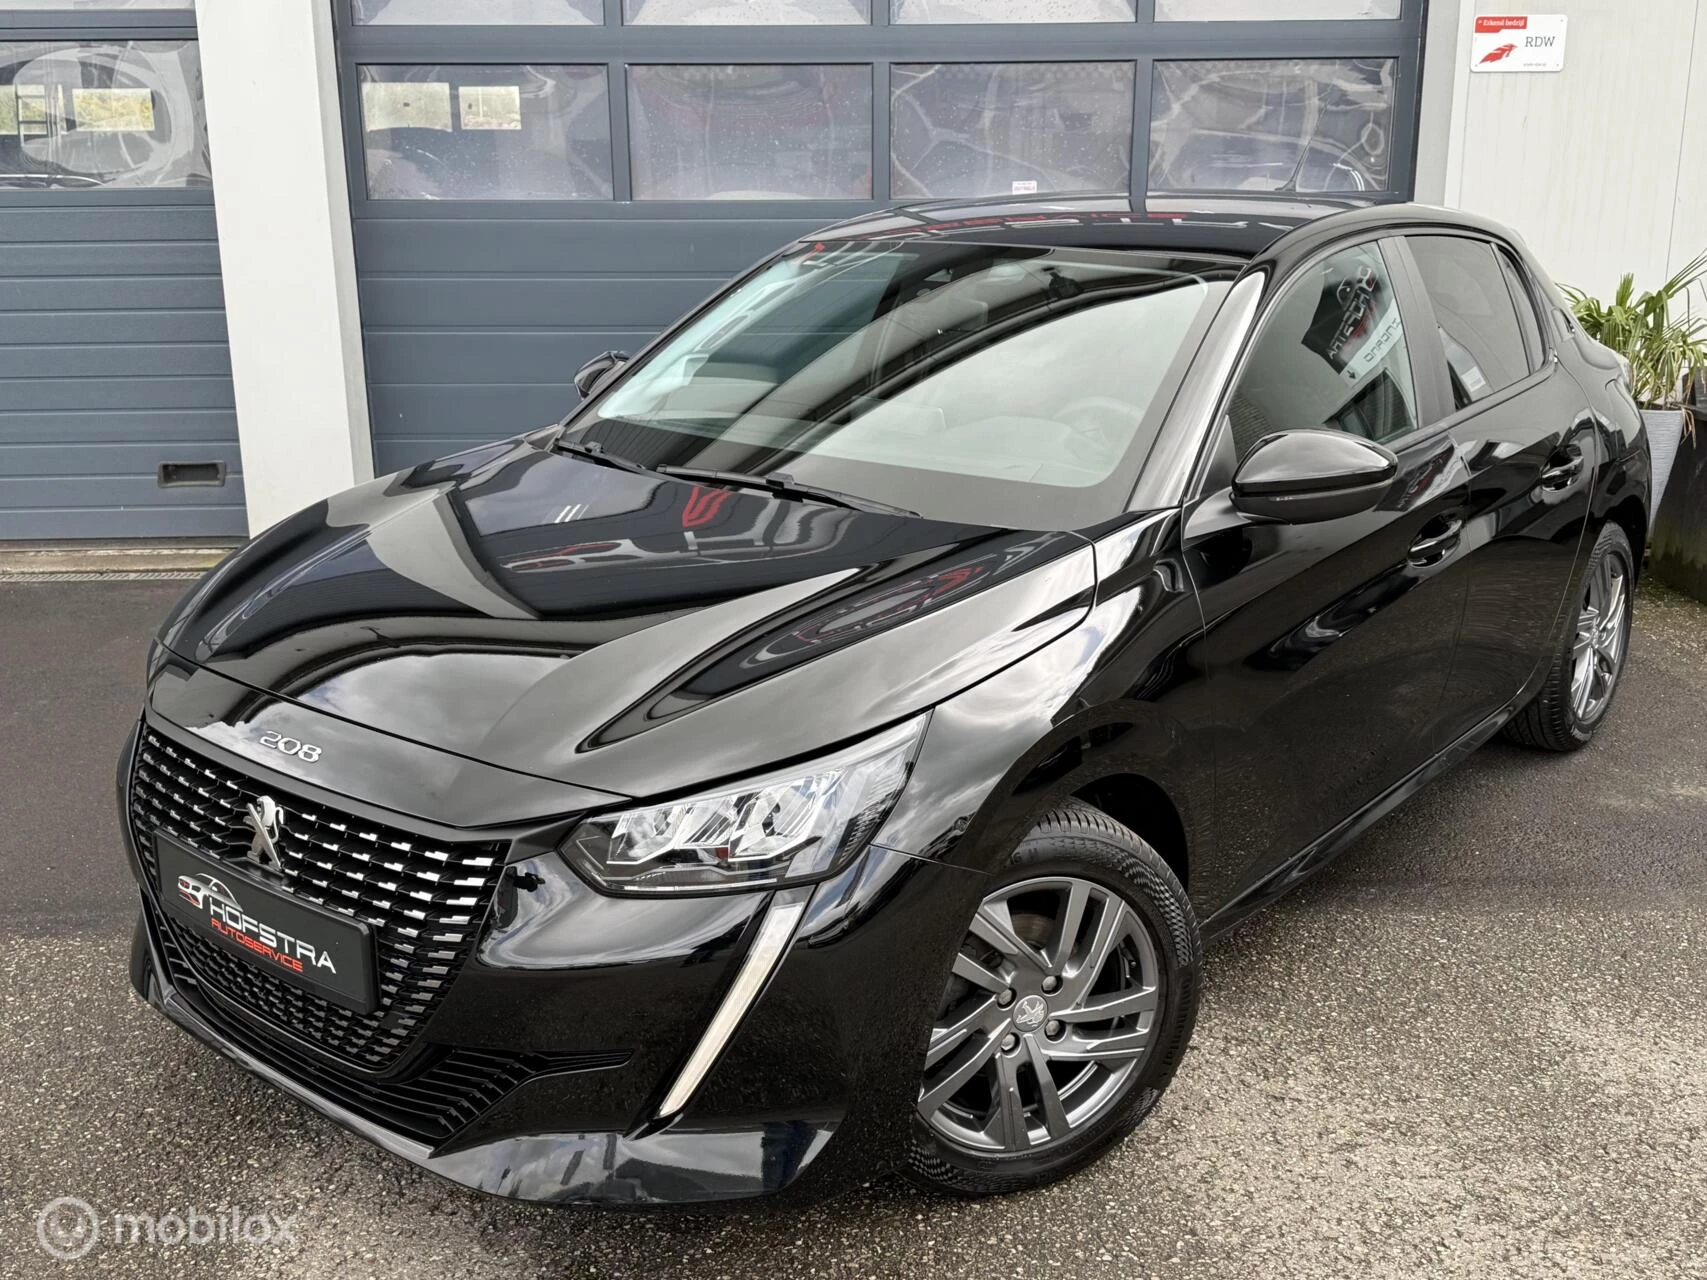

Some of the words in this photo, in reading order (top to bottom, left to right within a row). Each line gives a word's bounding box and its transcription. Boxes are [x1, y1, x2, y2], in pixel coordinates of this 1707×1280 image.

[1525, 36, 1555, 47] RDW
[259, 731, 322, 762] 208
[209, 897, 337, 974] HOFSTRA
[211, 918, 303, 972] AUTOSERVICE
